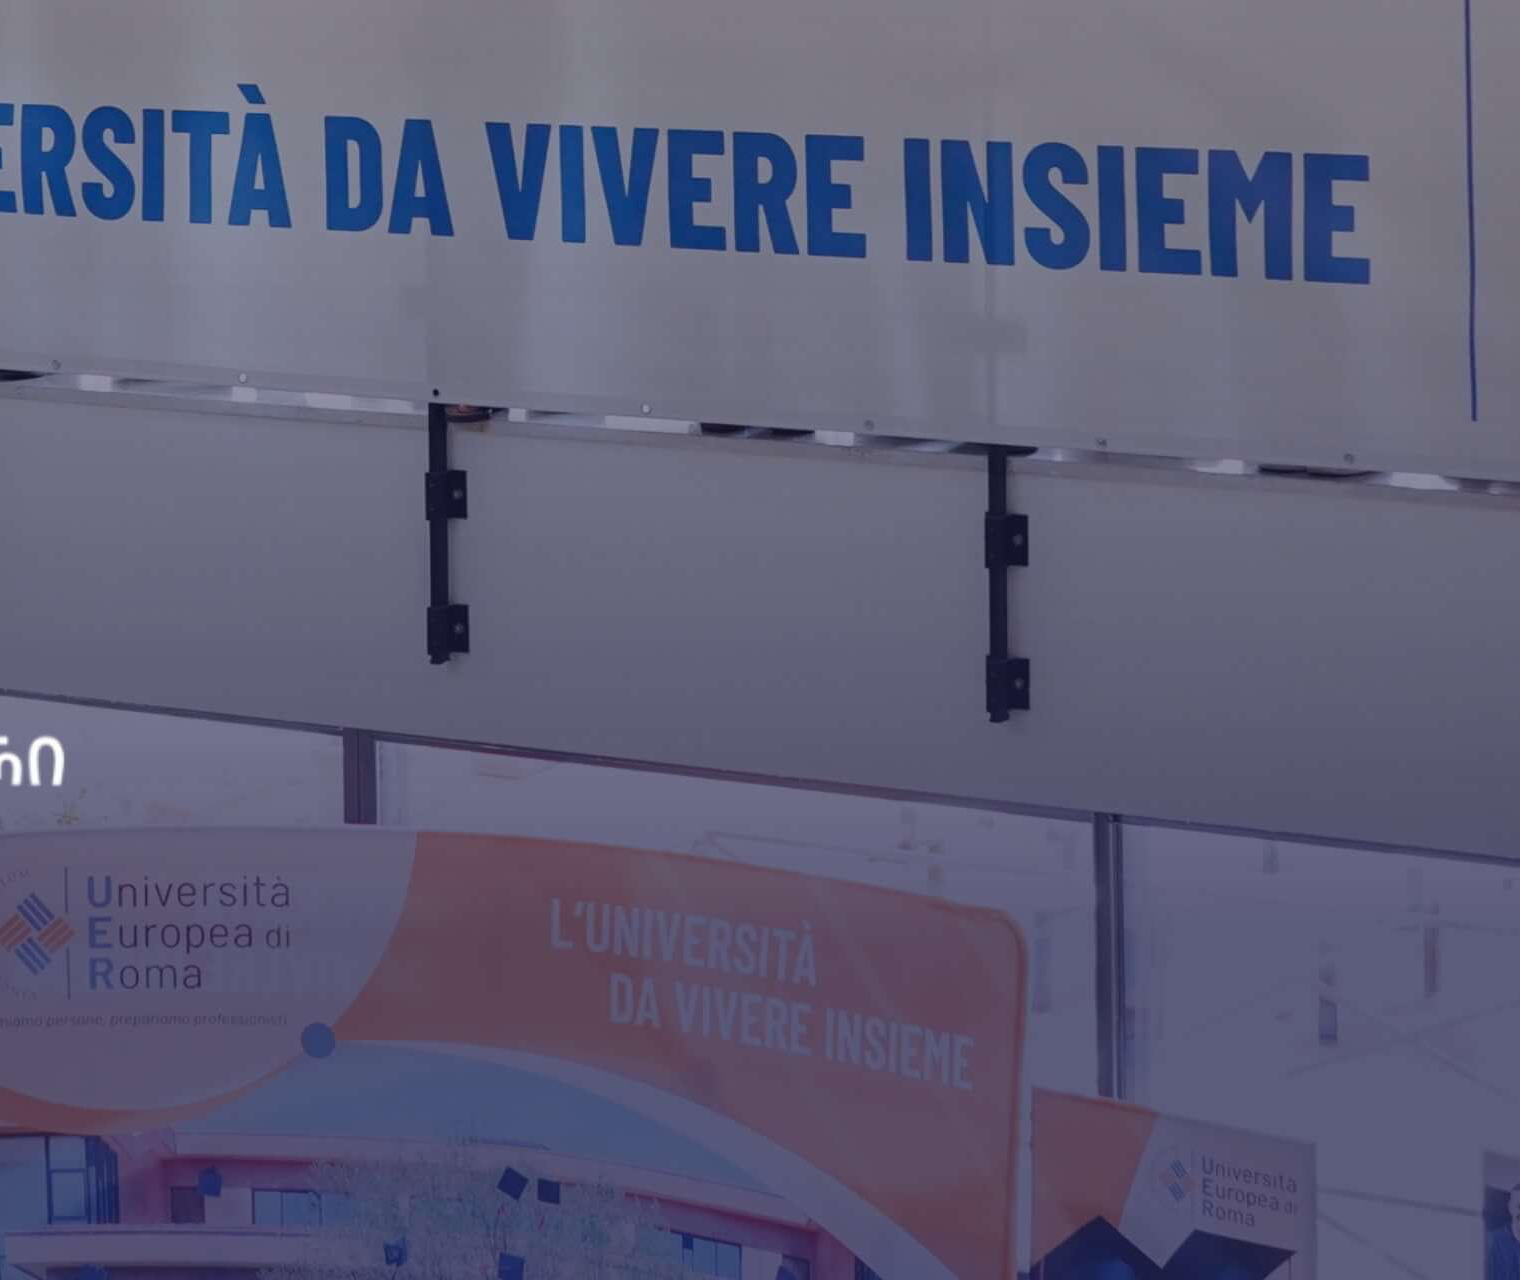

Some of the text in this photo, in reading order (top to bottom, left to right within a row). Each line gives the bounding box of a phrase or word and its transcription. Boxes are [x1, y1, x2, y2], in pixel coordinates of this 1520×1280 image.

[324, 115, 455, 237] DA
[485, 122, 867, 258] VIVERE
[904, 138, 1371, 284] INSIEME
[87, 875, 290, 908] Università
[88, 916, 291, 954] Europea di
[549, 897, 817, 987] L'UNIVERSITÀ
[89, 957, 202, 990] Roma
[609, 972, 976, 1090] DA VIVERE INSIEME
[1201, 1154, 1297, 1193] Università
[1201, 1178, 1280, 1212] Europea
[1201, 1199, 1256, 1227] Roma
